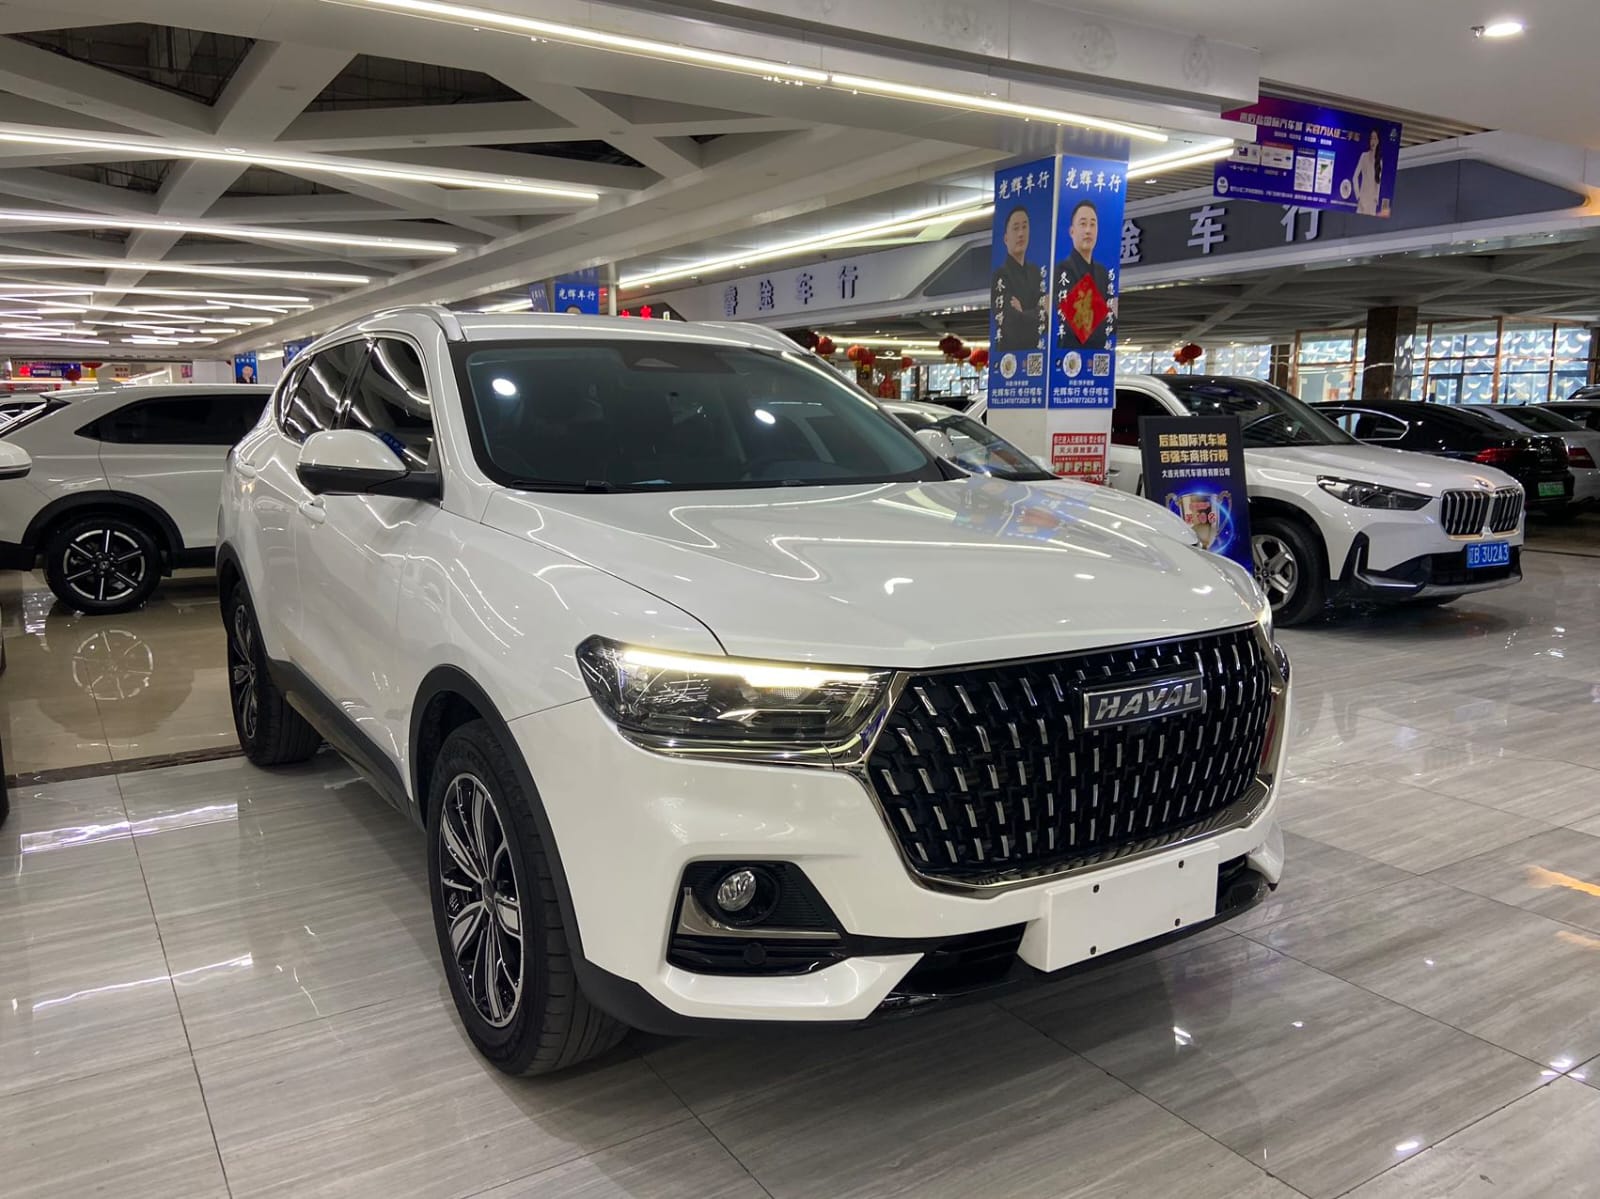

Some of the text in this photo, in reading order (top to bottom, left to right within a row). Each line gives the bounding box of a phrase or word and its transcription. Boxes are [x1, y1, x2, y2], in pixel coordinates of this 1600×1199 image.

[999, 170, 1050, 199] 光辉车行
[1065, 167, 1122, 193] 光辉车行
[1053, 387, 1080, 397] 光辉车行
[1159, 433, 1227, 447] 后盐国际汽车城
[1160, 449, 1229, 463] 百强车商排行榜
[1095, 682, 1200, 721] HAVAL
